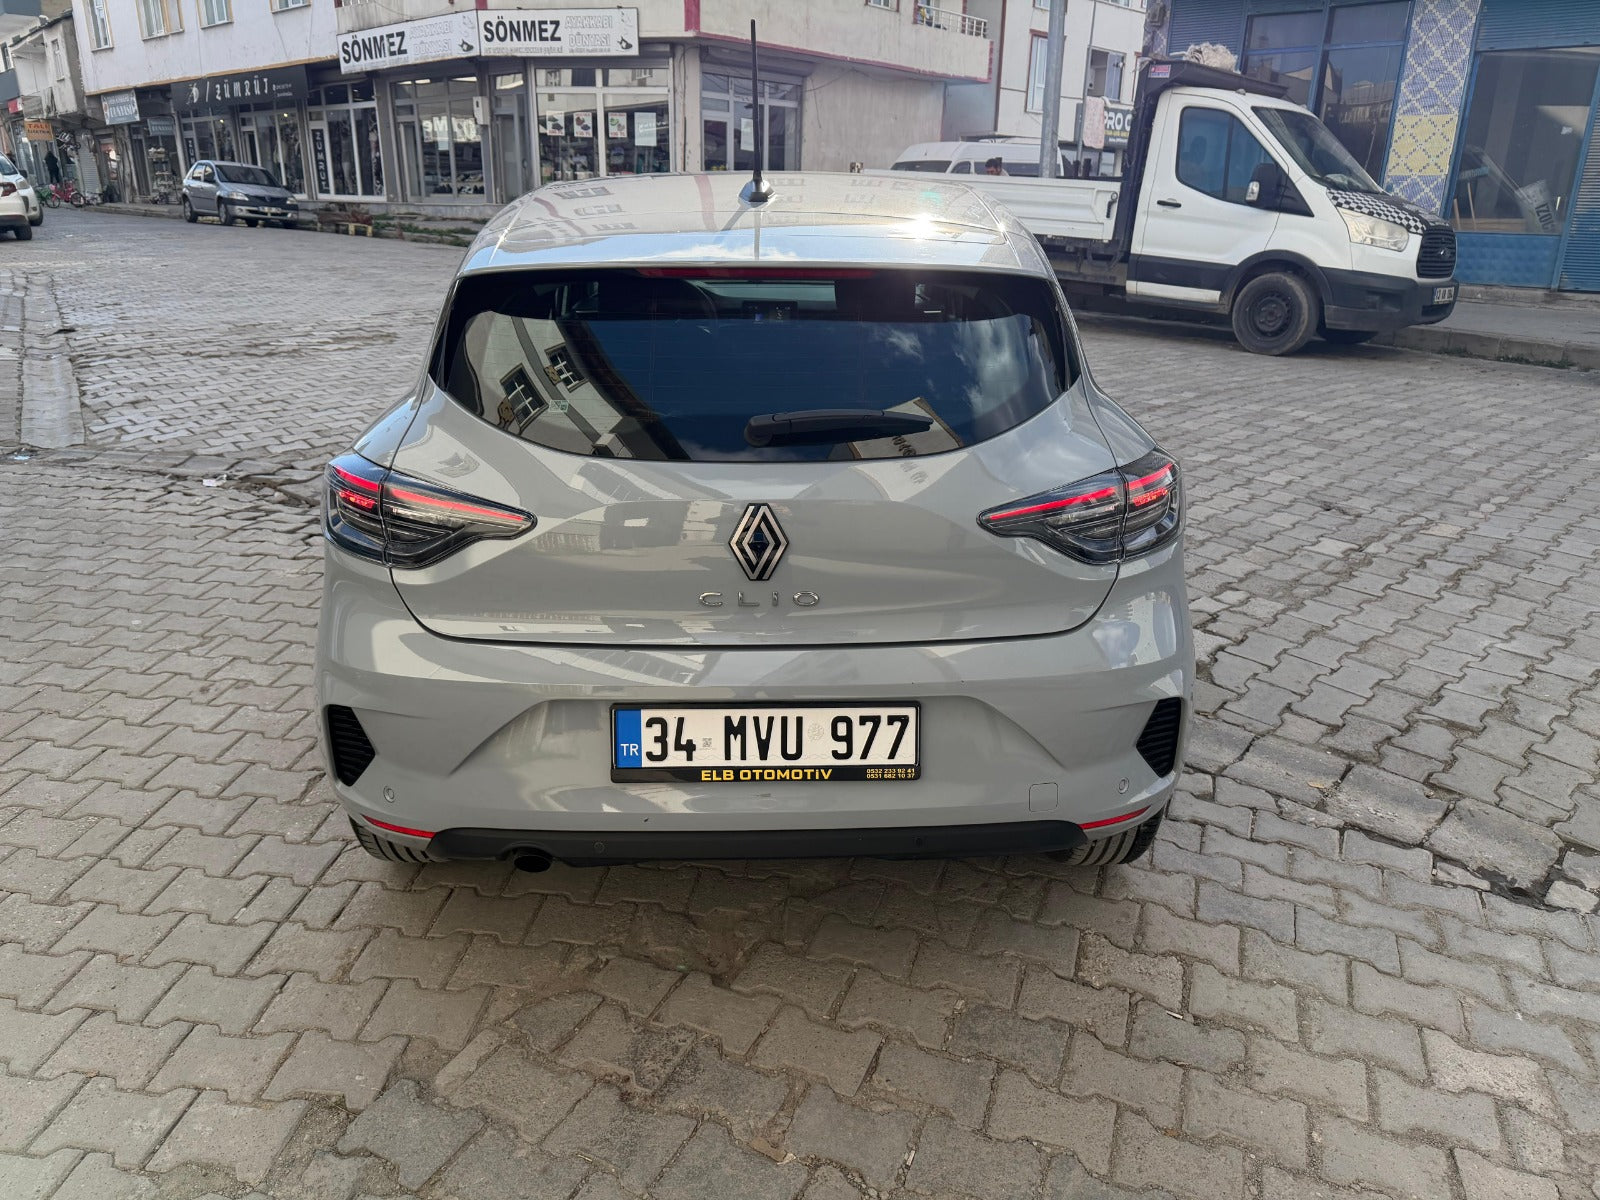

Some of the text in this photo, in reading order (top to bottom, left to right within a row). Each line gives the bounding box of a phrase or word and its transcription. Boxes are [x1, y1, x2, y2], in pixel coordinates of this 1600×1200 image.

[484, 15, 562, 42] SÖNMEZ
[565, 15, 613, 29] AYAKKABI
[341, 31, 408, 64] SÖNMEZ
[568, 33, 611, 47] DÜNYASI
[699, 591, 820, 607] CLIO
[645, 714, 911, 762] 34 MVU 977
[620, 743, 640, 756] TR
[701, 770, 735, 781] ELB
